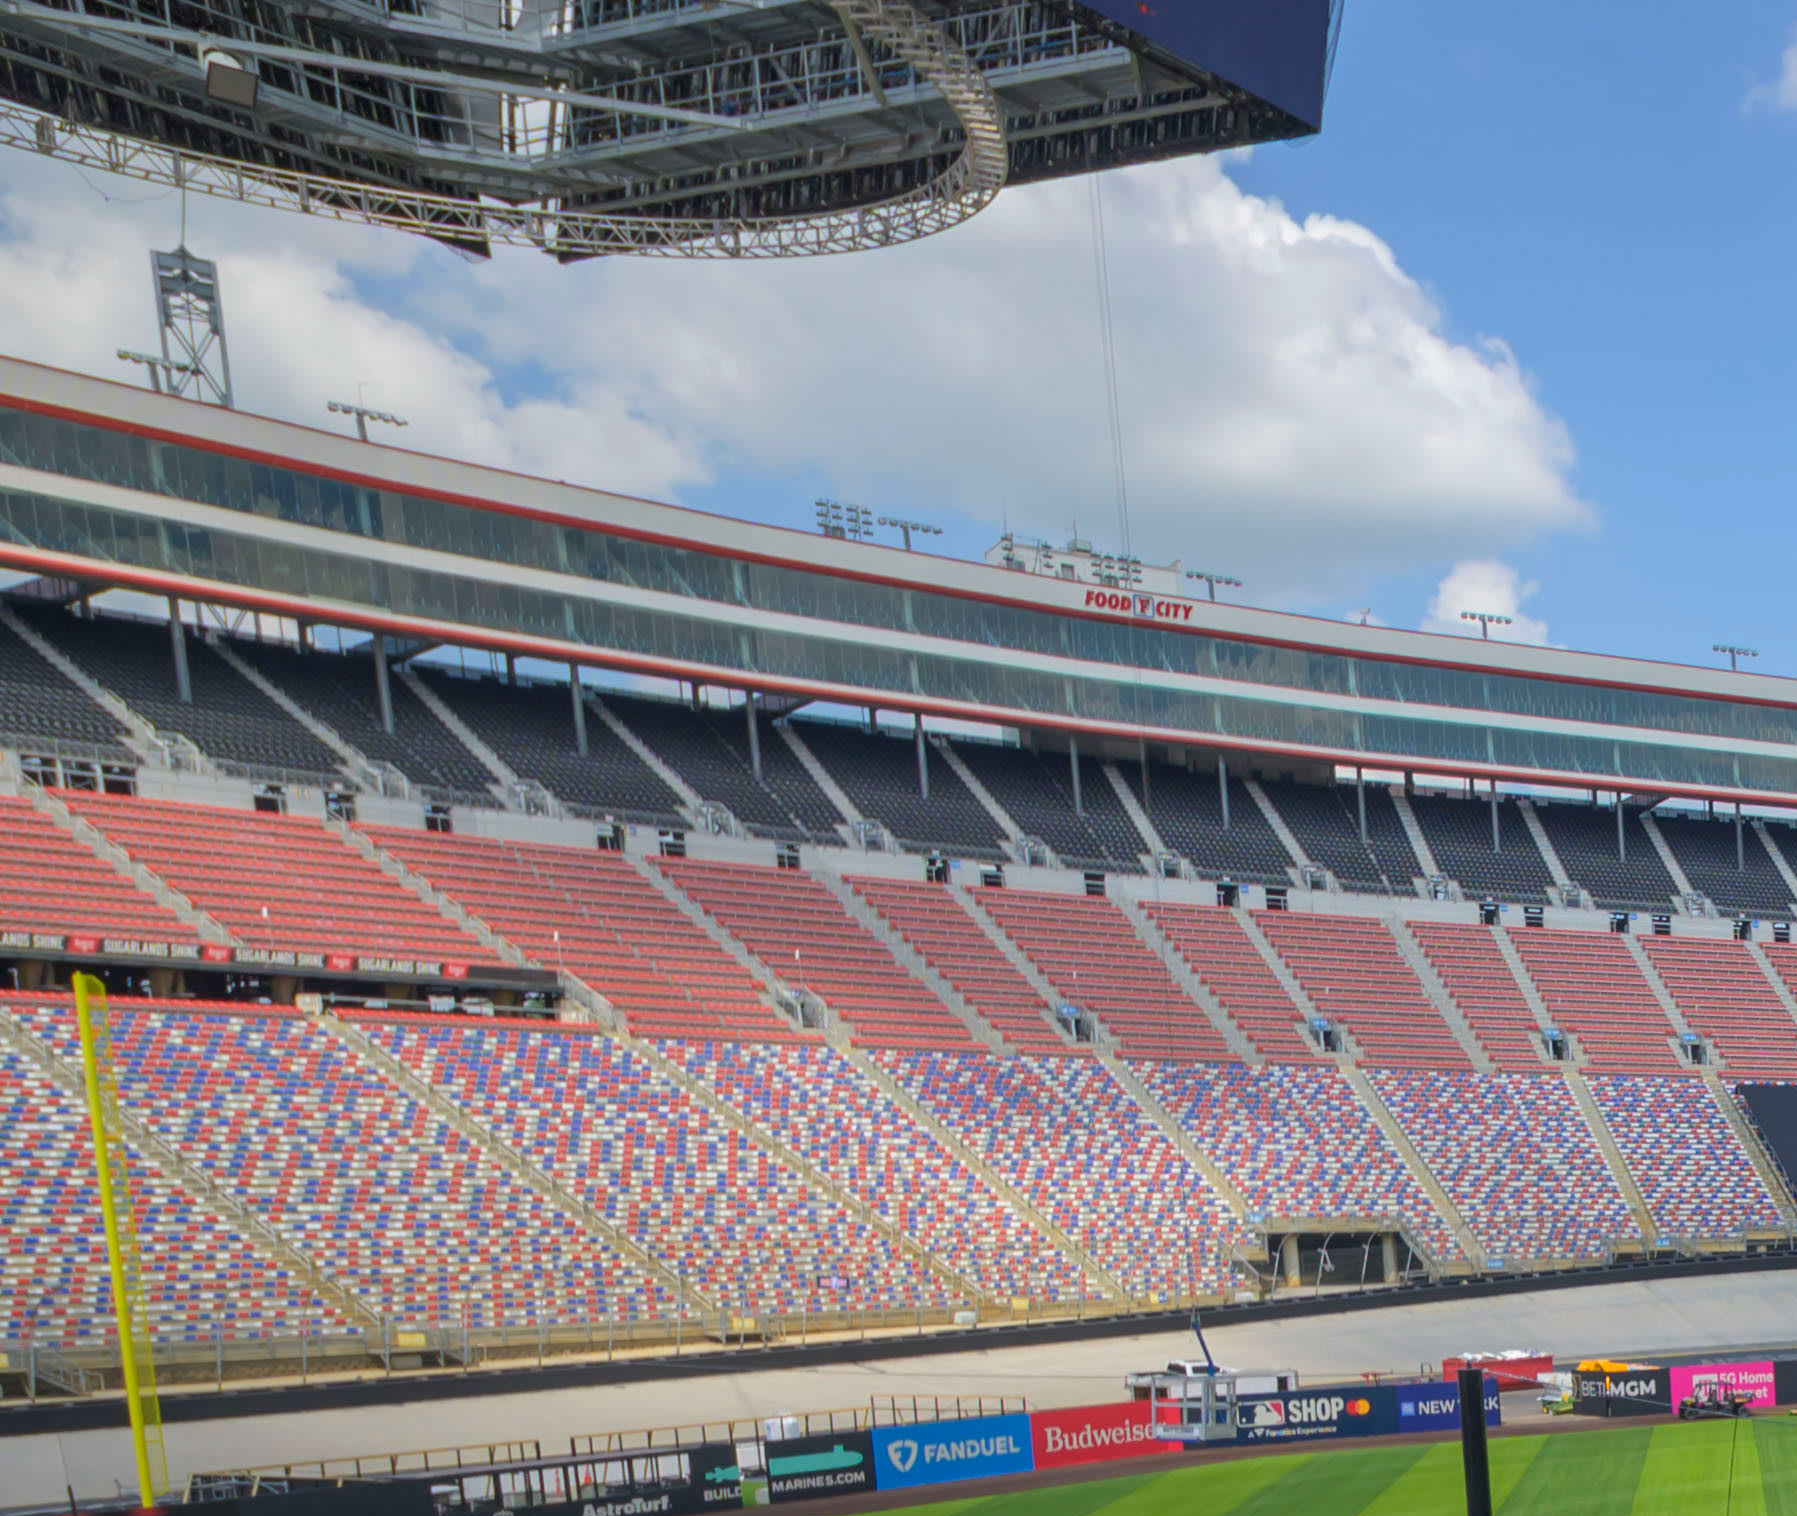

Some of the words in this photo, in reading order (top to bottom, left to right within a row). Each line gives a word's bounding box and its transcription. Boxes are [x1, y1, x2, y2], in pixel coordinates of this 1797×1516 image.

[1085, 590, 1132, 612] FOOD
[1155, 601, 1193, 620] CITY
[104, 939, 168, 957] SUGARLANDS
[236, 949, 295, 966] SUGARLANDS
[1739, 1370, 1774, 1384] Home
[1288, 1396, 1345, 1423] SHOP
[1418, 1400, 1456, 1416] NEW
[1045, 1418, 1166, 1453] Budweise
[924, 1435, 1021, 1464] FANDUEL
[772, 1471, 866, 1494] MARINES.COM
